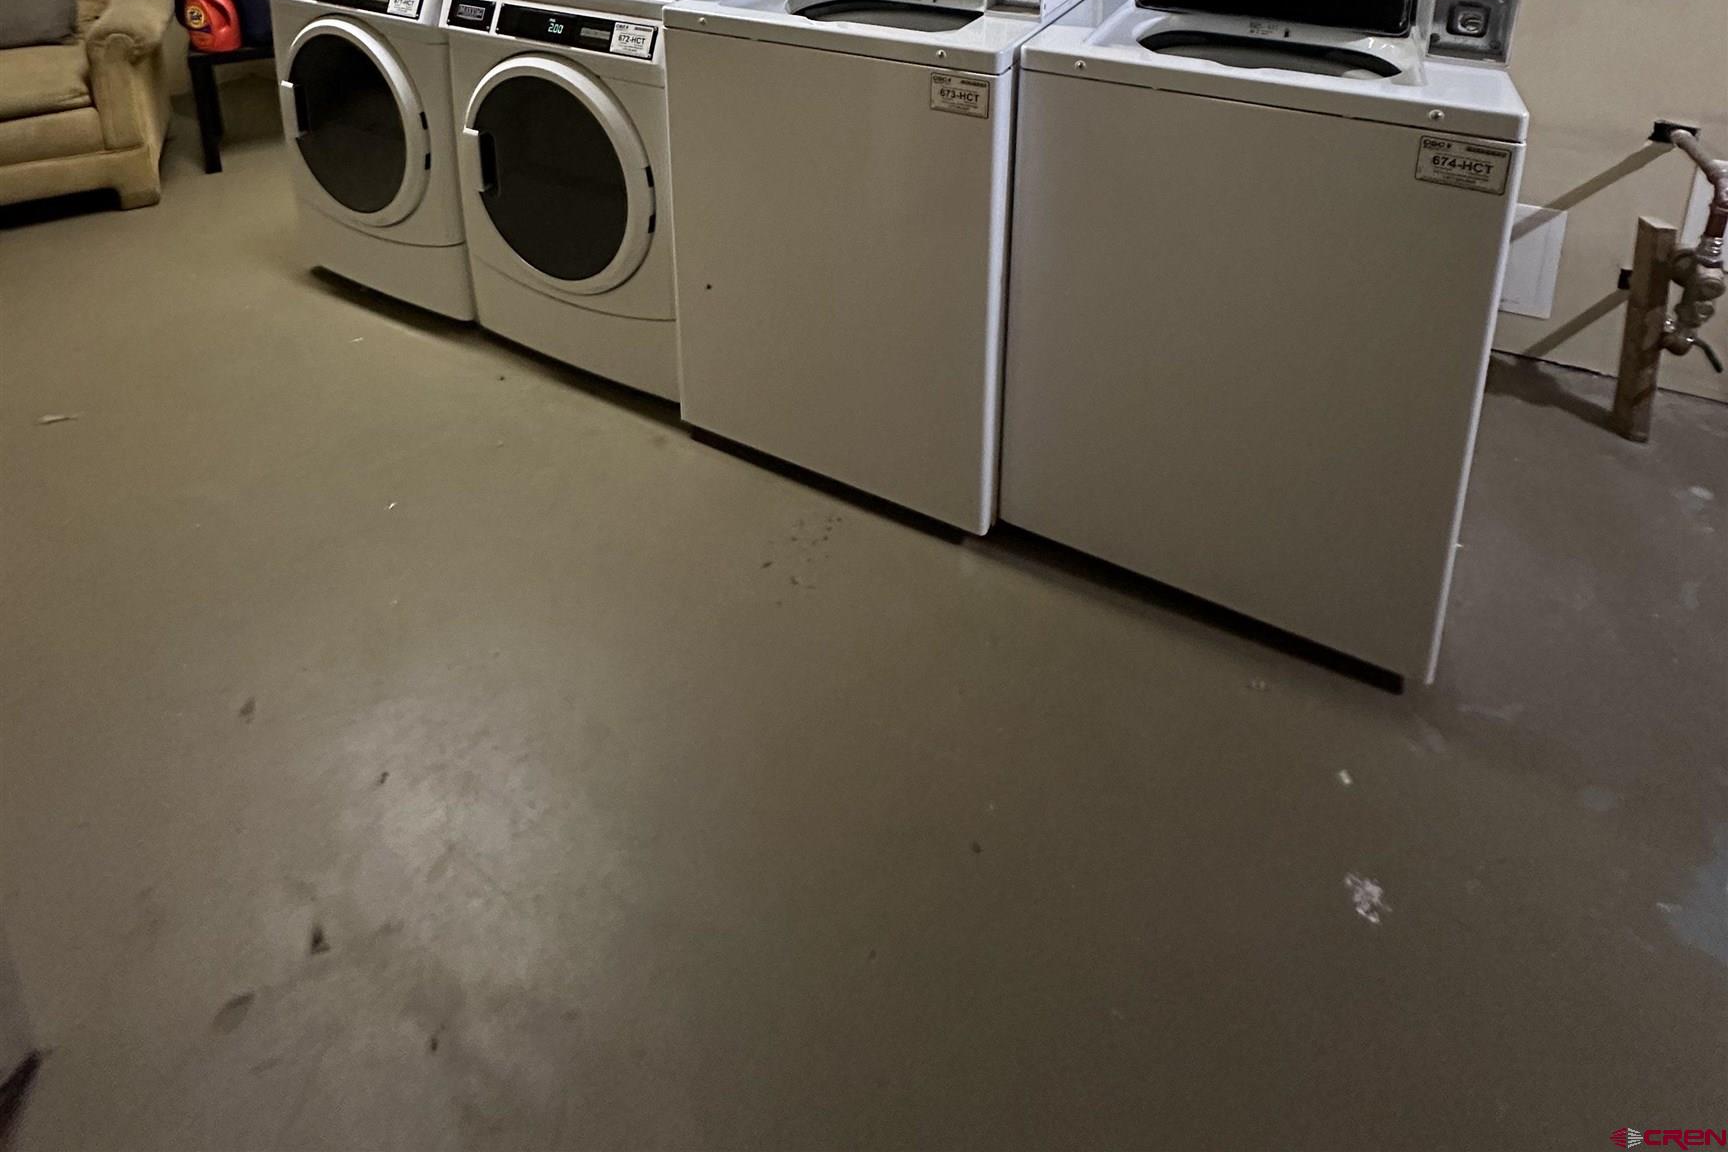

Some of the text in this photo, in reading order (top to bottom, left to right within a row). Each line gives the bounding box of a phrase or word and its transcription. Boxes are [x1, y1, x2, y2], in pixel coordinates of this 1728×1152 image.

[618, 34, 646, 45] 672-HCT
[939, 88, 980, 102] 673-HCT
[1432, 155, 1494, 174] 674-HCT
